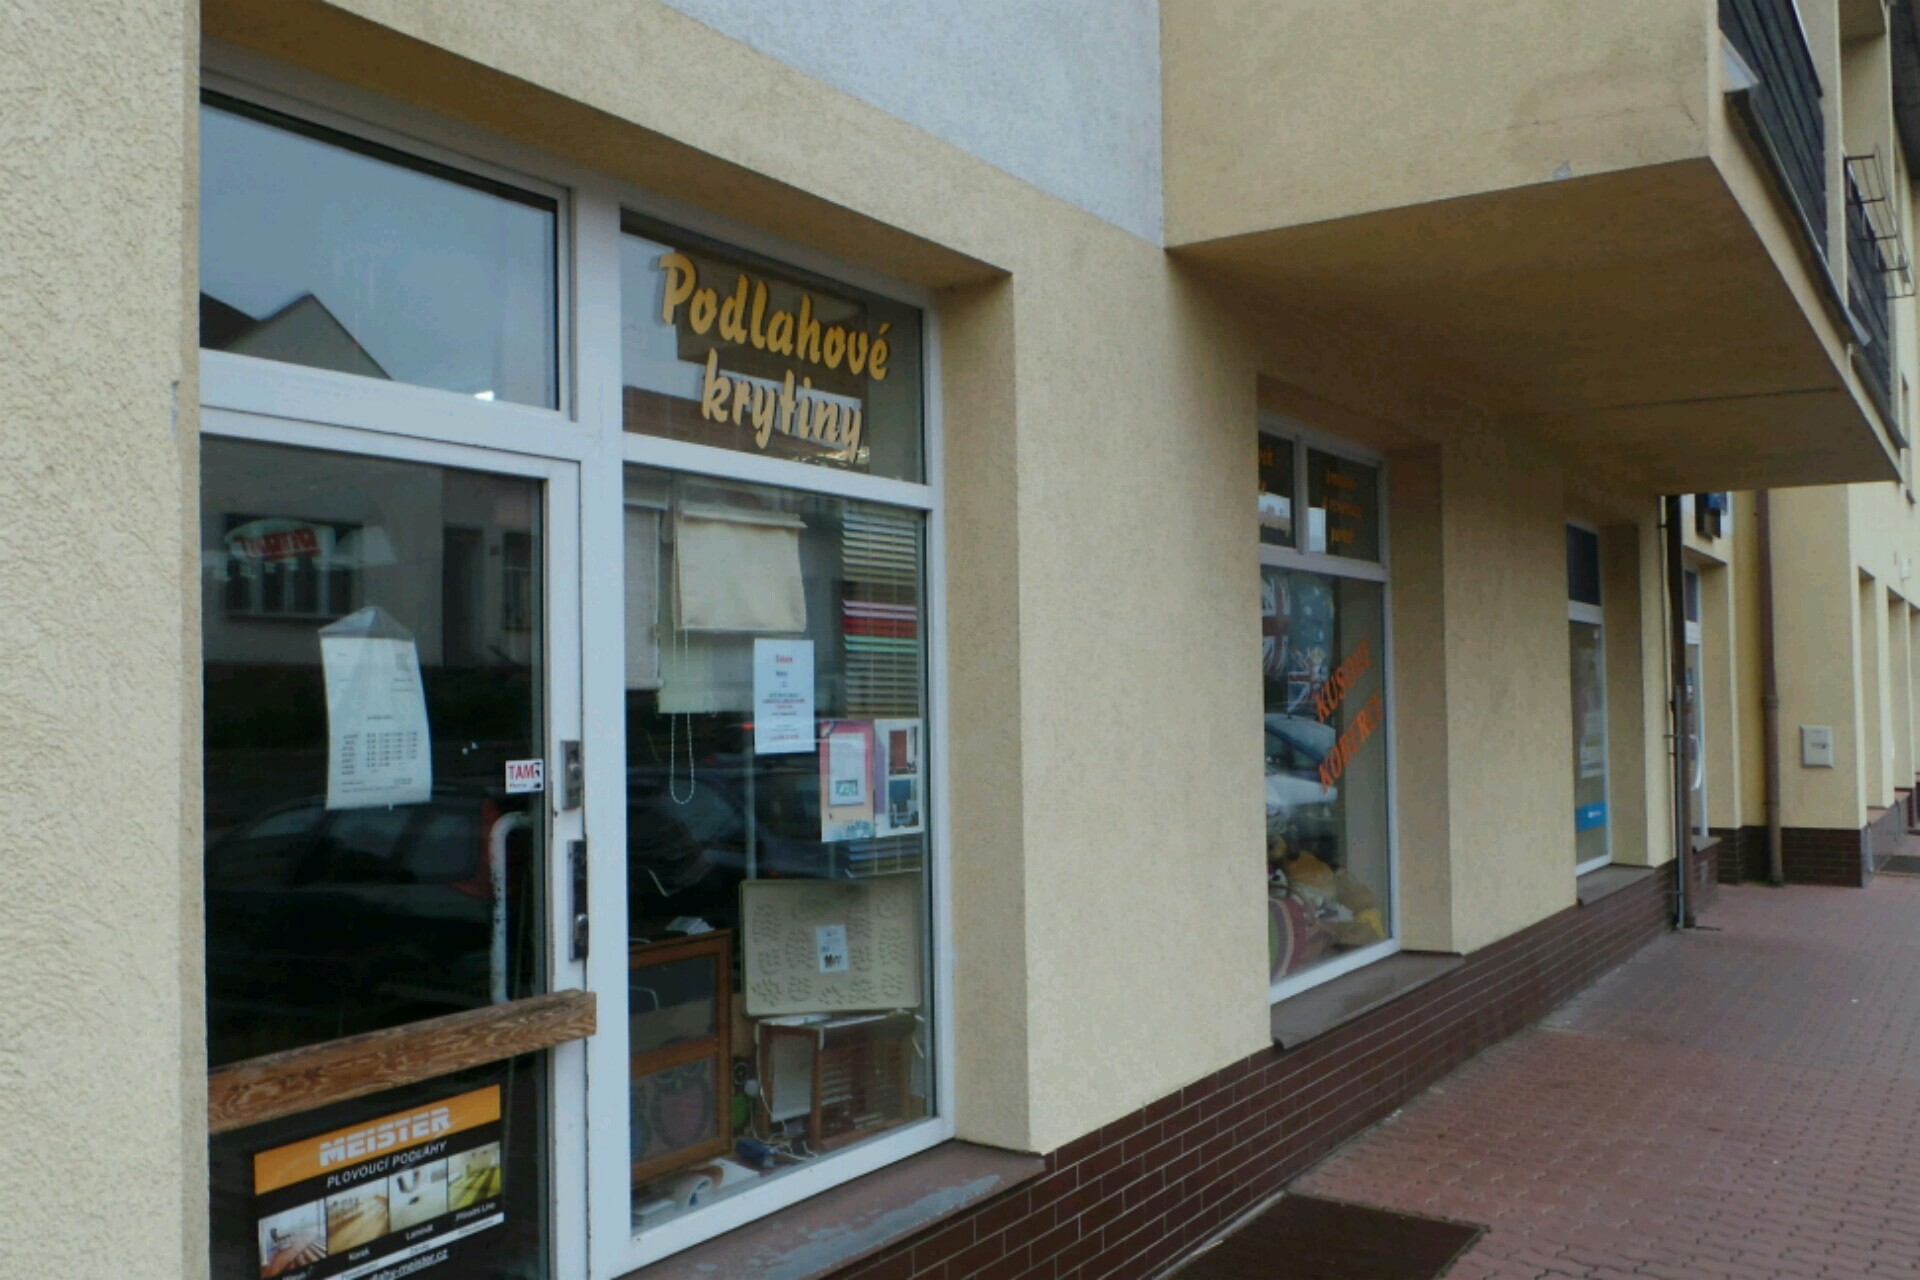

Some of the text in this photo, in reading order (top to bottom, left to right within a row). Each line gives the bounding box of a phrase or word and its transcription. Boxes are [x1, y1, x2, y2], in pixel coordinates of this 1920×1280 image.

[659, 253, 891, 381] Podlahové
[702, 347, 863, 464] krytiny
[392, 1140, 448, 1168] PODLAHY
